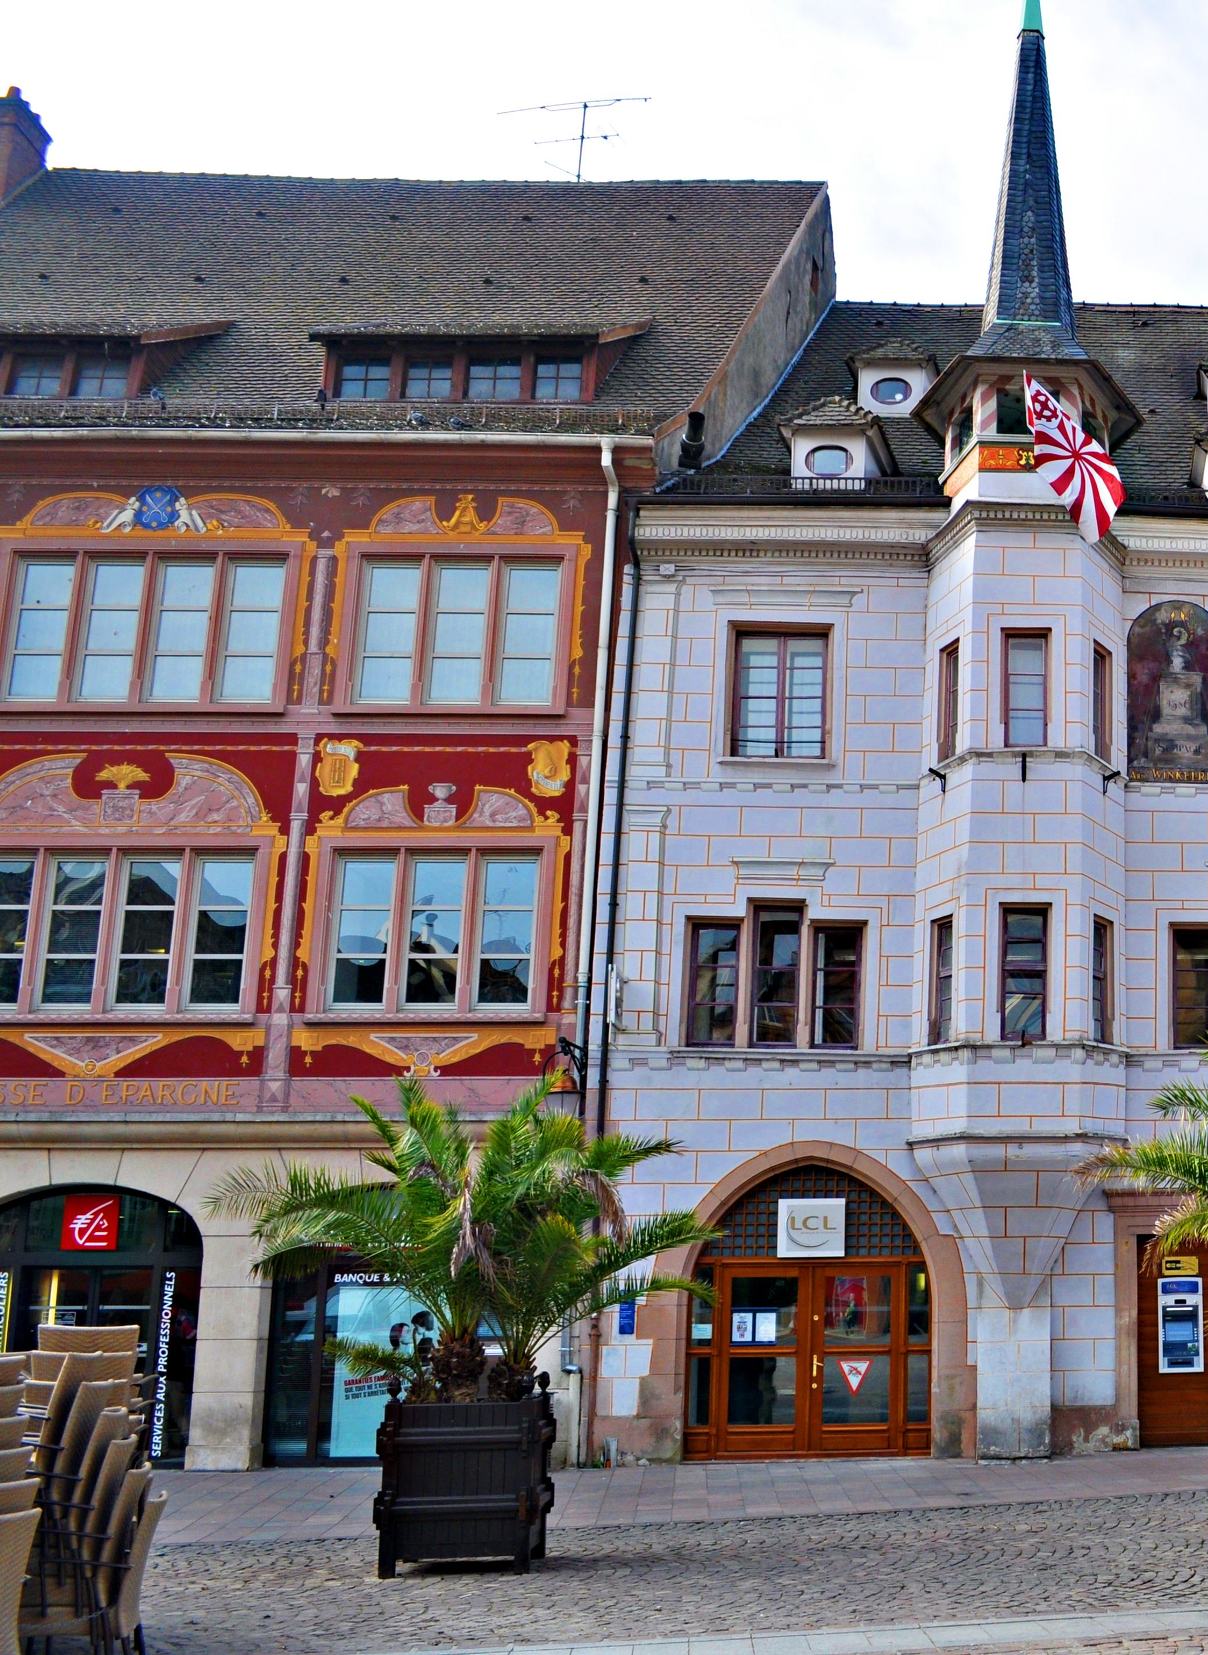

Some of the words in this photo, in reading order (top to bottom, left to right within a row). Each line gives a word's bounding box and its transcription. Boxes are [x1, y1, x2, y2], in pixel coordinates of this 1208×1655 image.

[790, 1215, 838, 1231] LCL
[334, 1273, 381, 1284] BANQUE
[383, 1273, 391, 1282] &
[157, 1271, 176, 1372] PROFESSIONNELS
[155, 1375, 167, 1400] AUX
[152, 1403, 165, 1457] SERVICES
